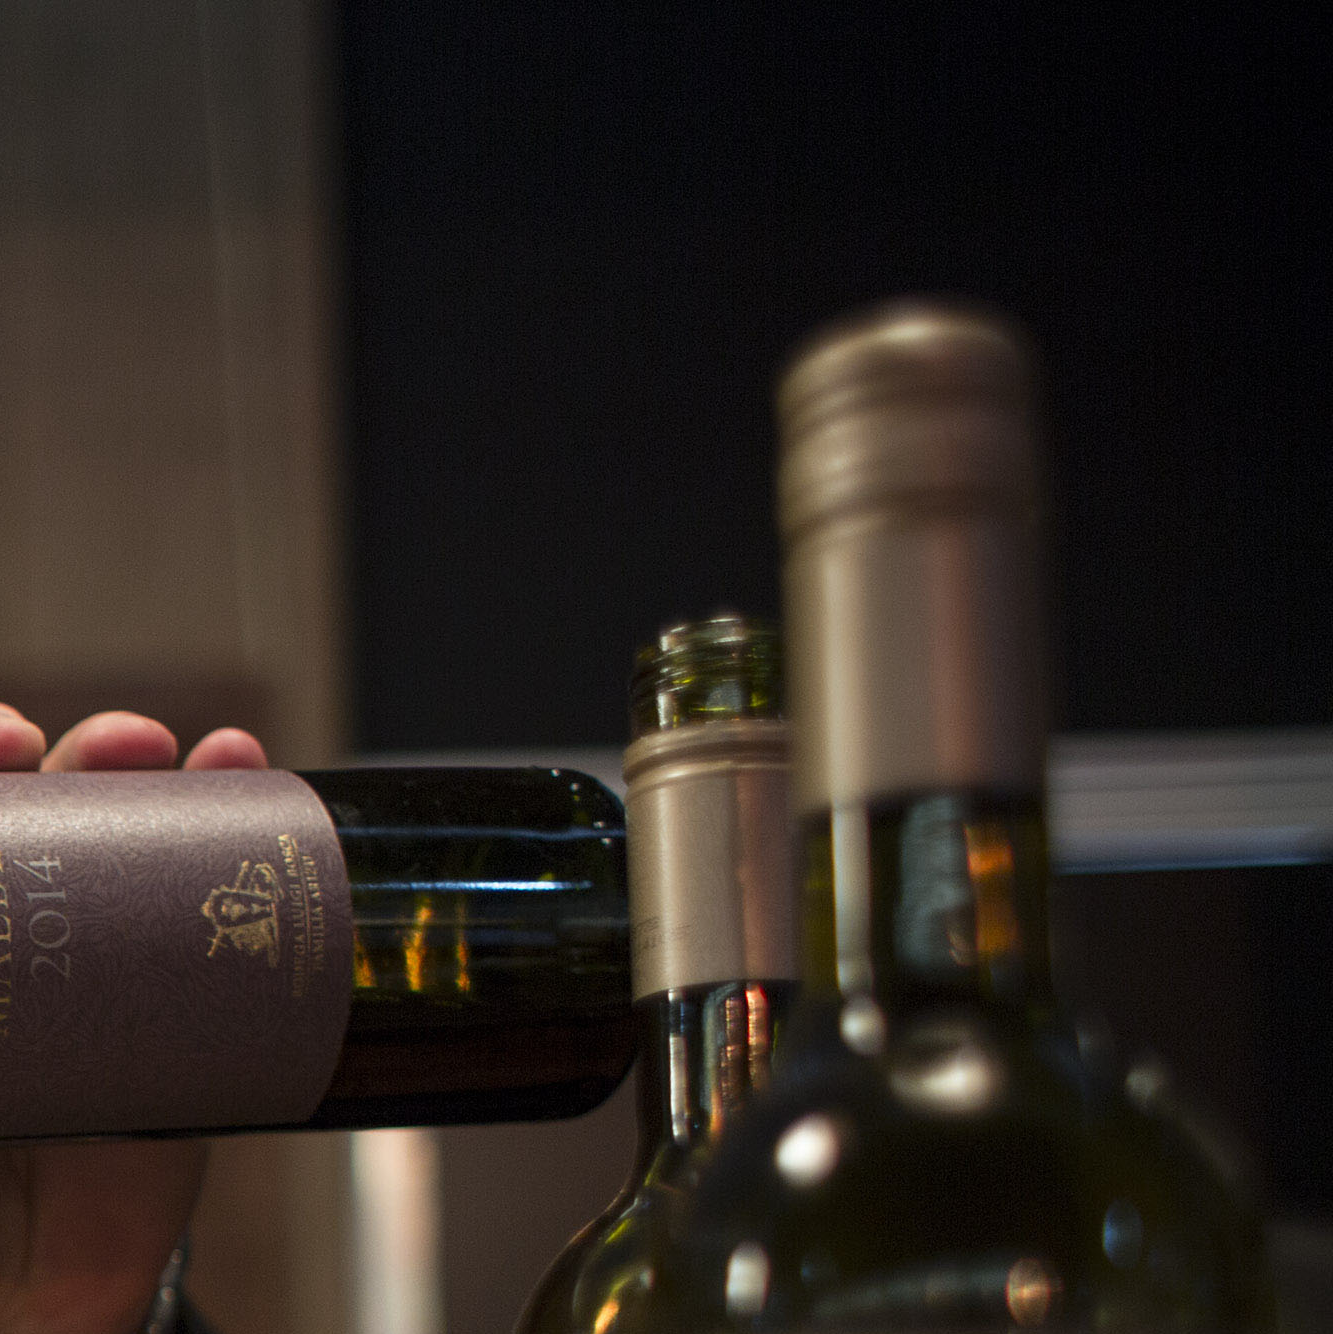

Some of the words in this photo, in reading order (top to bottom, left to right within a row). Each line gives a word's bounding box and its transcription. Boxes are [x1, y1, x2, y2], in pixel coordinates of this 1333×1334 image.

[12, 856, 71, 982] 2014
[288, 884, 306, 928] LUIGI
[309, 905, 327, 973] FAMILIA
